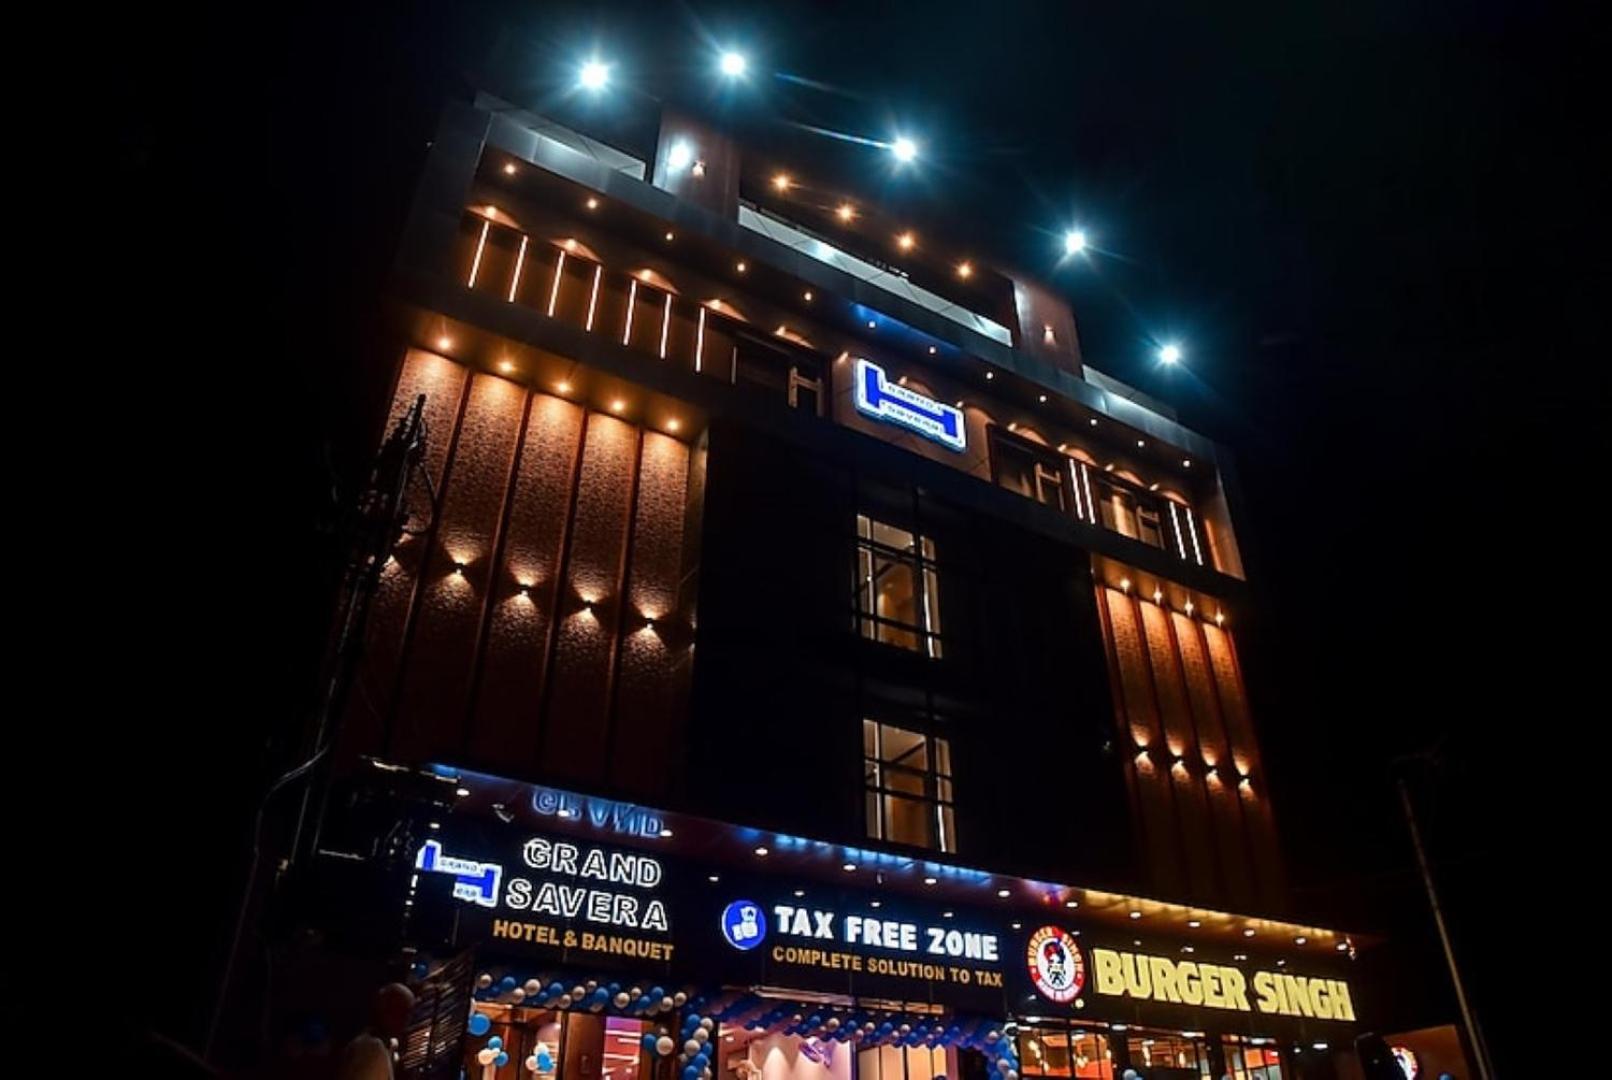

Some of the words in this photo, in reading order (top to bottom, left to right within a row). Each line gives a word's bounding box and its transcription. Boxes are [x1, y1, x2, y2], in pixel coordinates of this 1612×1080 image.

[523, 838, 662, 888] GRAND
[505, 878, 668, 931] SAVERA
[493, 920, 560, 947] HOTEL
[564, 928, 578, 948] &
[582, 931, 674, 961] BANQUET
[774, 906, 834, 939] TAX
[844, 916, 917, 951] FREE
[926, 928, 999, 960] ZONE
[773, 945, 862, 972] COMPLETE
[867, 957, 945, 982] SOLUTION
[949, 967, 970, 984] TO
[975, 970, 1003, 987] TAX
[1093, 948, 1251, 1012] BURGER
[1253, 971, 1356, 1021] SINGH
